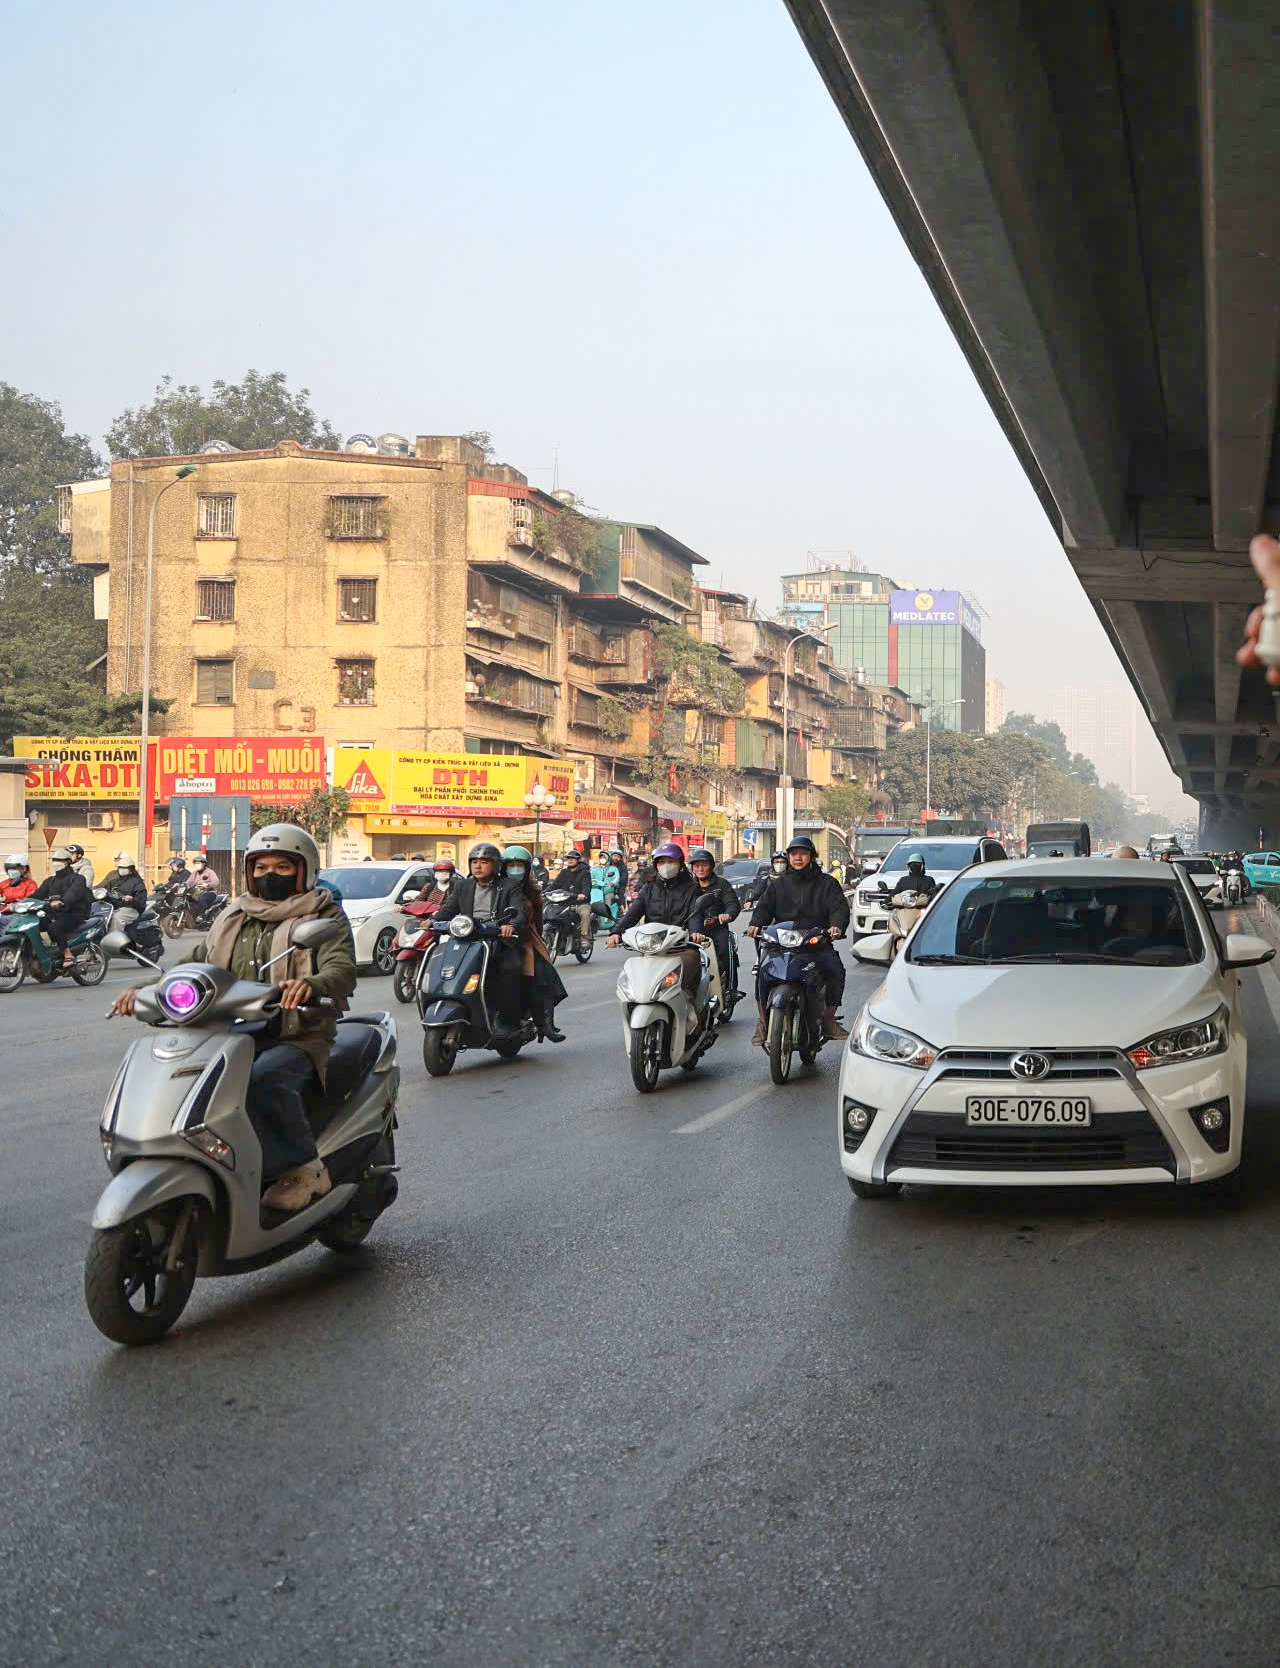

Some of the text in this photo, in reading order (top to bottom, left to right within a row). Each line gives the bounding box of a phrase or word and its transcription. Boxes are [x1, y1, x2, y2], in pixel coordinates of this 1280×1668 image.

[893, 611, 955, 621] MEDLATEC
[272, 698, 316, 732] C3
[38, 747, 137, 761] CHỐNG THẤM
[163, 743, 208, 779] DIỆT
[214, 741, 253, 774] MỐI
[267, 739, 320, 774] MUỖI
[344, 772, 378, 794] Sika
[432, 767, 488, 786] DTH
[574, 803, 596, 820] CHỐNG
[599, 804, 617, 821] THẤM
[970, 1099, 1086, 1122] 30E-076.09
